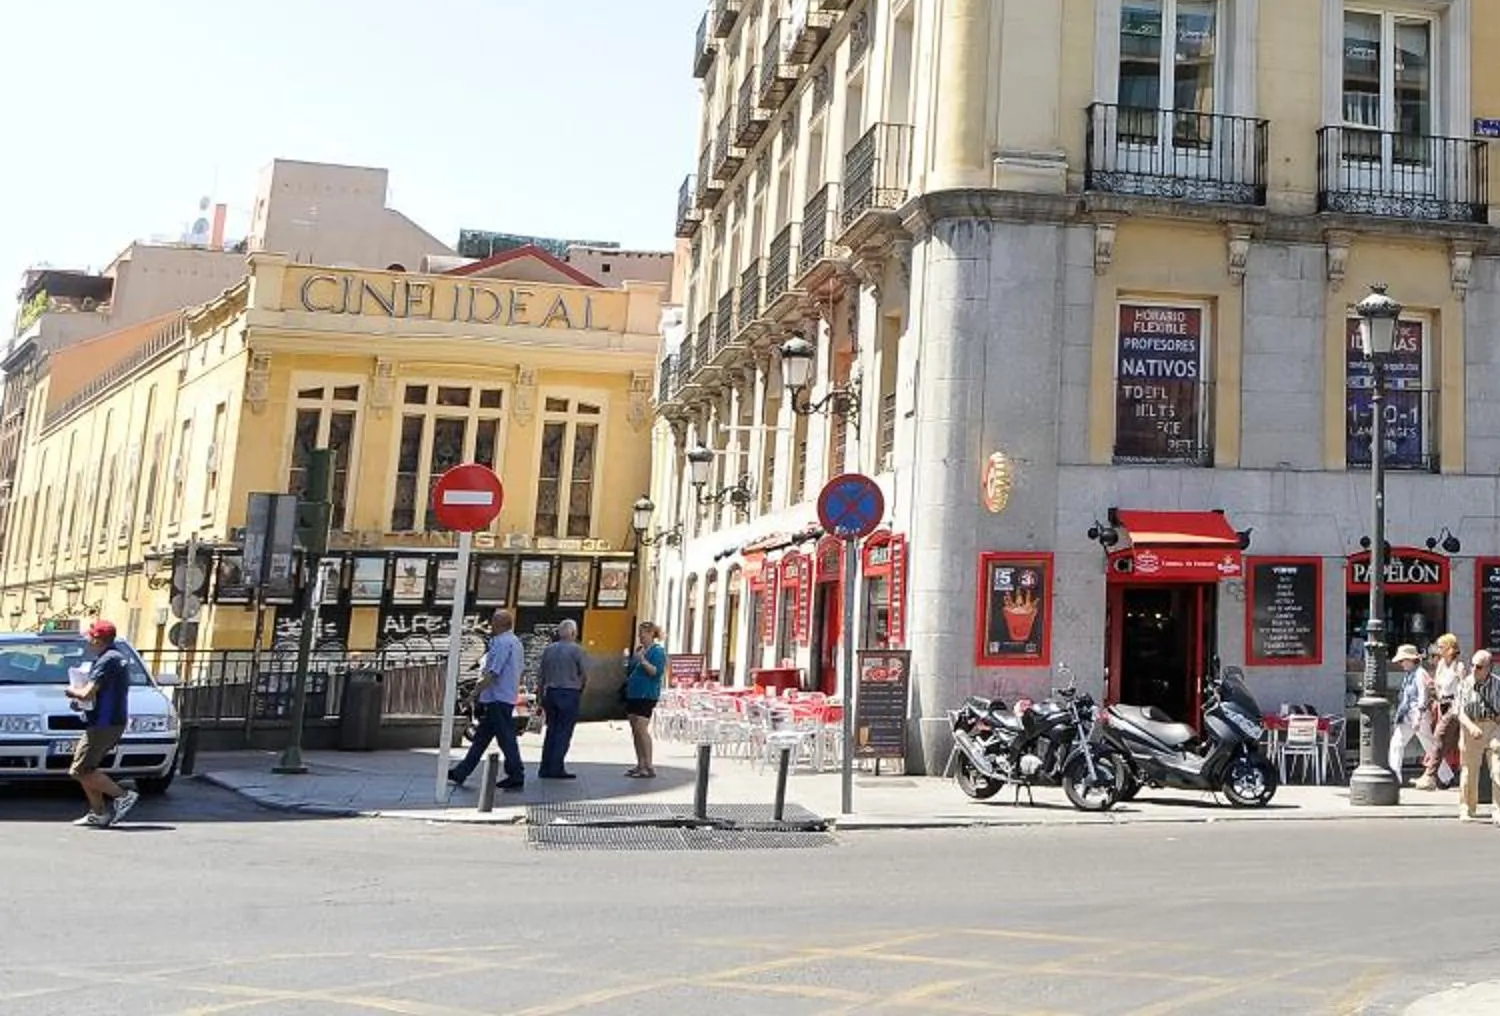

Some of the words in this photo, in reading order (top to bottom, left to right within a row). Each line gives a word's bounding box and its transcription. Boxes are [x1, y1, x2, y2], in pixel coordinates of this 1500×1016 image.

[301, 275, 434, 318] CINE
[451, 283, 609, 332] IDEAL
[1135, 309, 1186, 323] HORARIO
[1133, 321, 1187, 335] FLEXIBLE
[1123, 337, 1196, 353] PROFESORES
[1121, 359, 1197, 377] NATIVOS
